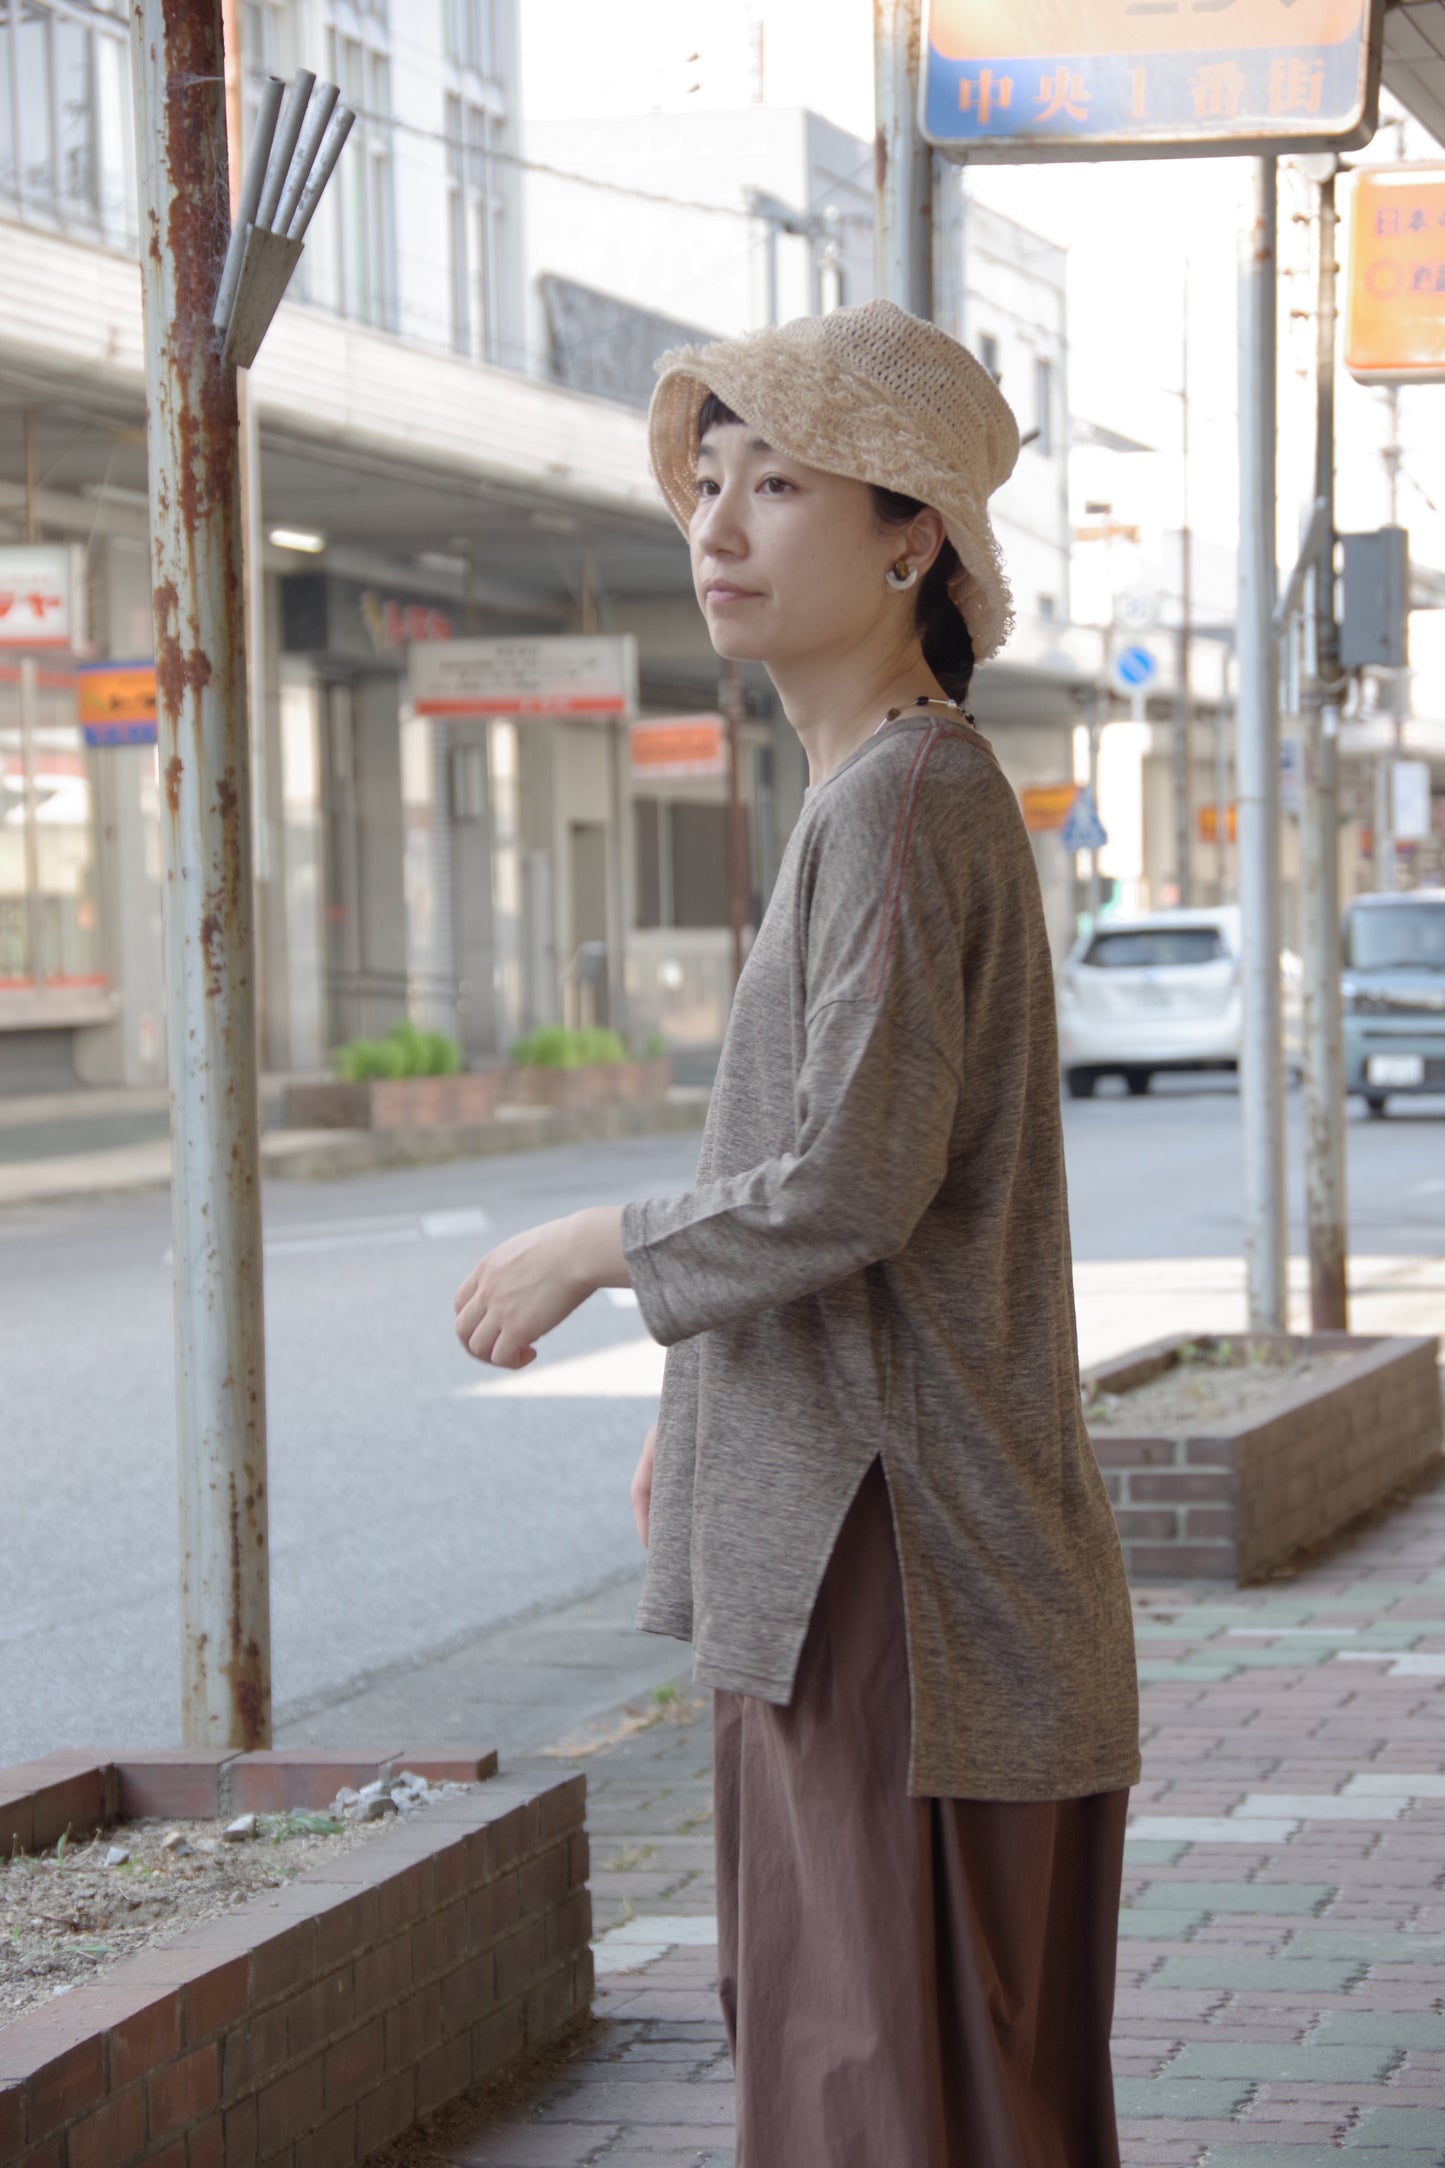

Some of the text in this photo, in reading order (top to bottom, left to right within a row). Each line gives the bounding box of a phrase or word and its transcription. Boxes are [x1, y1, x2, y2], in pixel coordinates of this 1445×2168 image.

[958, 57, 1325, 125] 中央1番街
[1375, 207, 1445, 236] 日本
